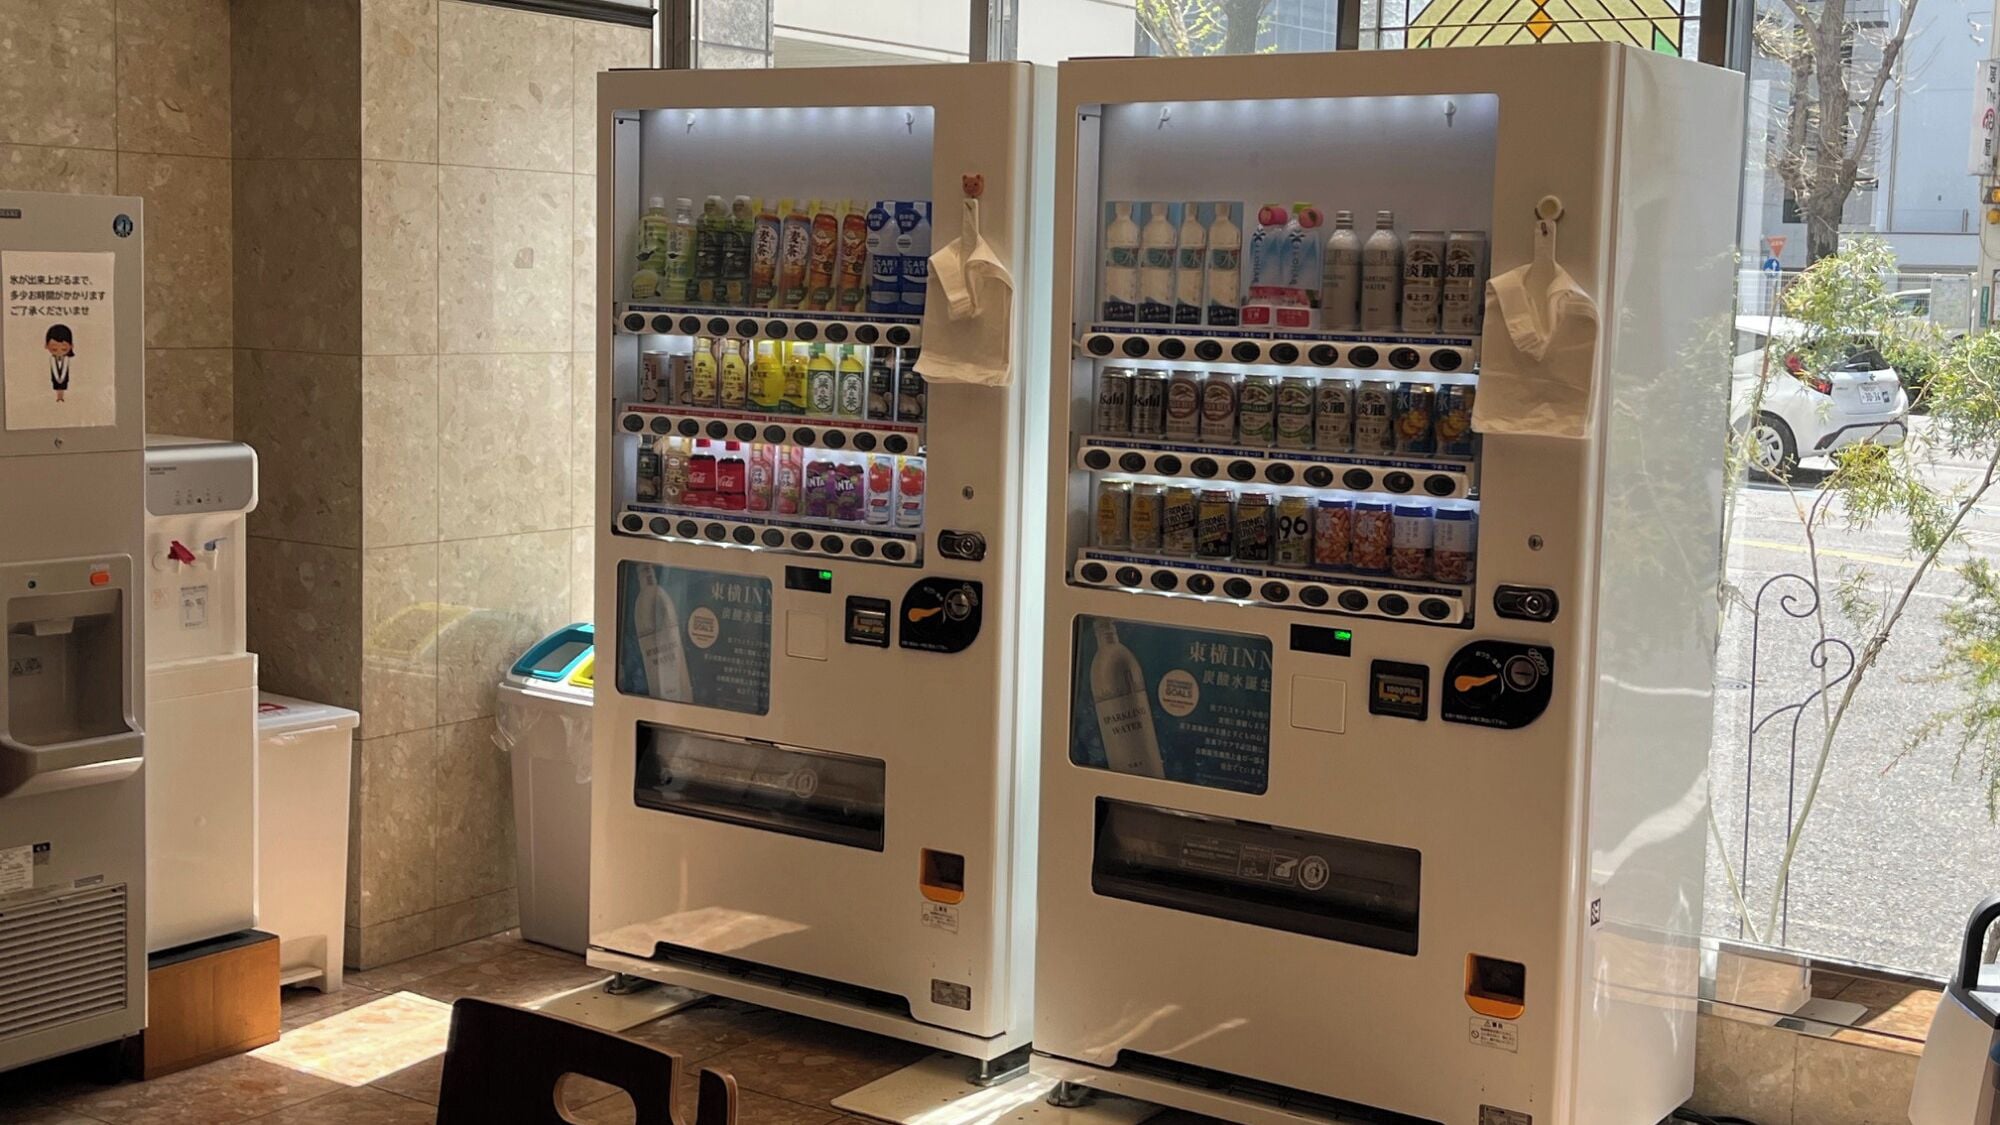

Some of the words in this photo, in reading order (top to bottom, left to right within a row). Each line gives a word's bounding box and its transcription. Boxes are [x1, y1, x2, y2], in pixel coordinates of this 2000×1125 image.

[10, 290, 105, 301] 多少お時間がかかります
[10, 305, 89, 316] ご了承くださいませ
